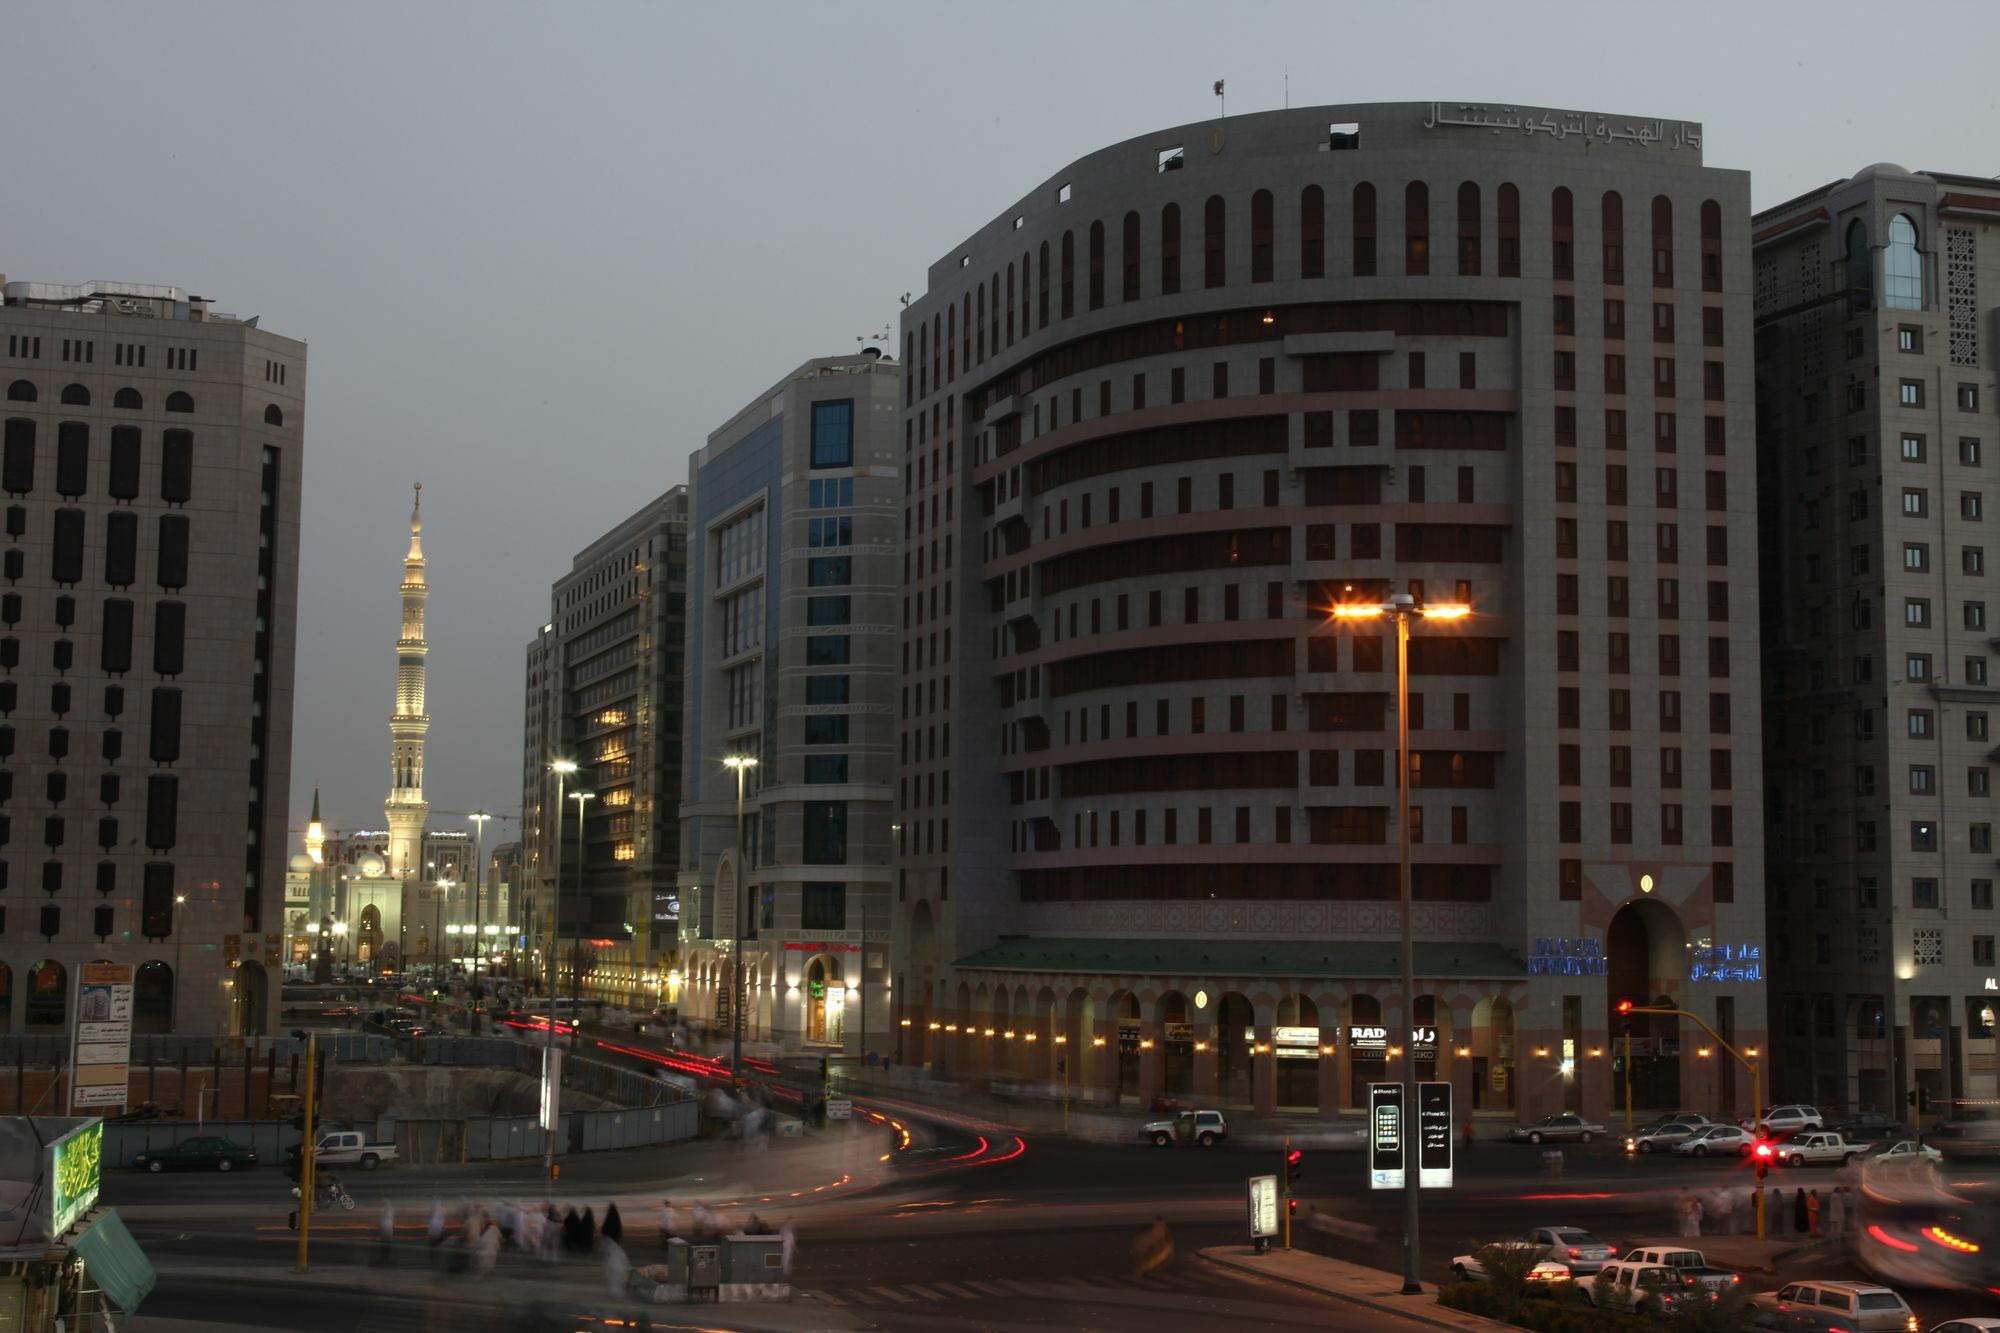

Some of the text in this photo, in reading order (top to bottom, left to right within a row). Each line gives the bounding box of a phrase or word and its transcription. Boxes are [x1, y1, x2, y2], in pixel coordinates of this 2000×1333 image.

[1596, 115, 1664, 147] الهجرة
[1671, 122, 1702, 150] دار
[1984, 977, 1999, 990] AL
[1351, 1027, 1387, 1038] RAD
